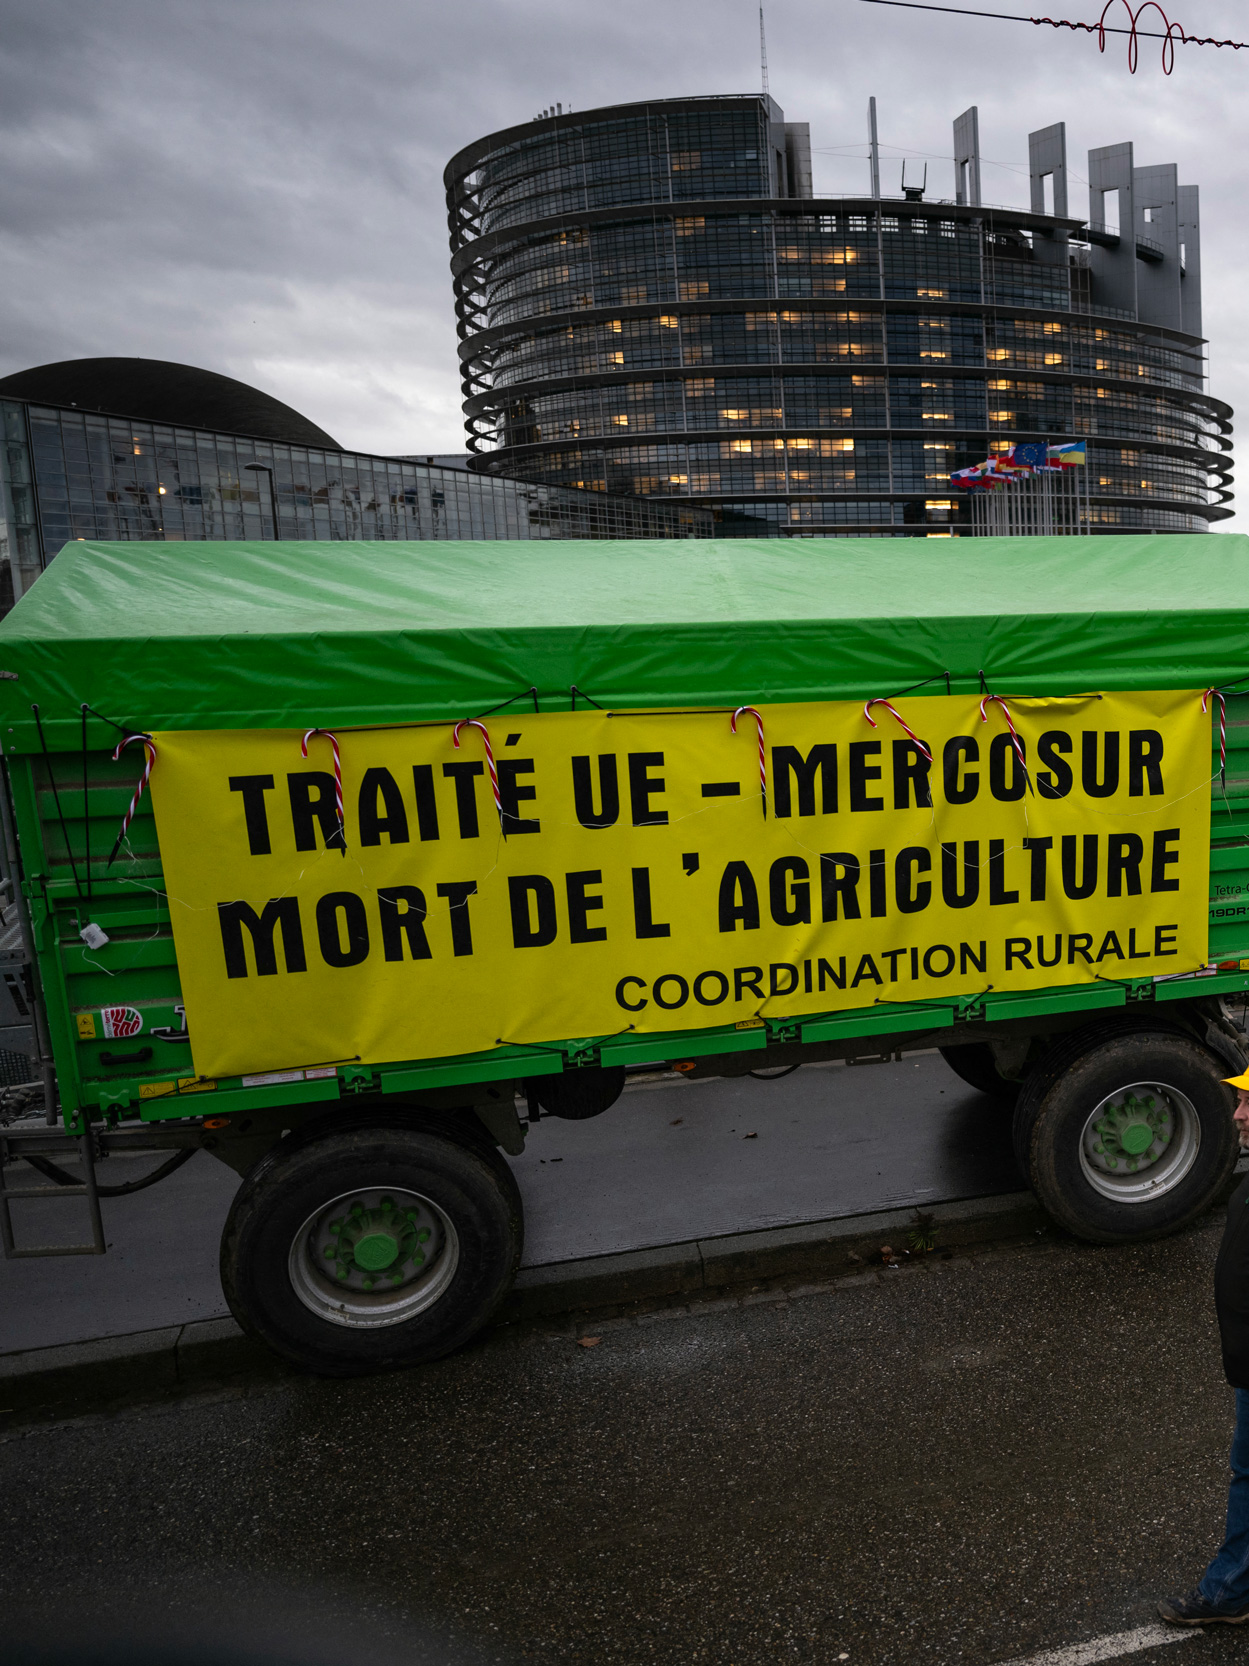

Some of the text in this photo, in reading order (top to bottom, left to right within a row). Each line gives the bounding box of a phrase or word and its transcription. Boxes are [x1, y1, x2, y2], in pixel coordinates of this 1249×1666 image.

[228, 733, 541, 857] TRAITÉ
[571, 751, 670, 829] UE
[772, 728, 1165, 819] MERCOSUR
[216, 881, 479, 980] MORT
[507, 868, 609, 950] DE
[615, 923, 1180, 1013] COORDINATION RURALE
